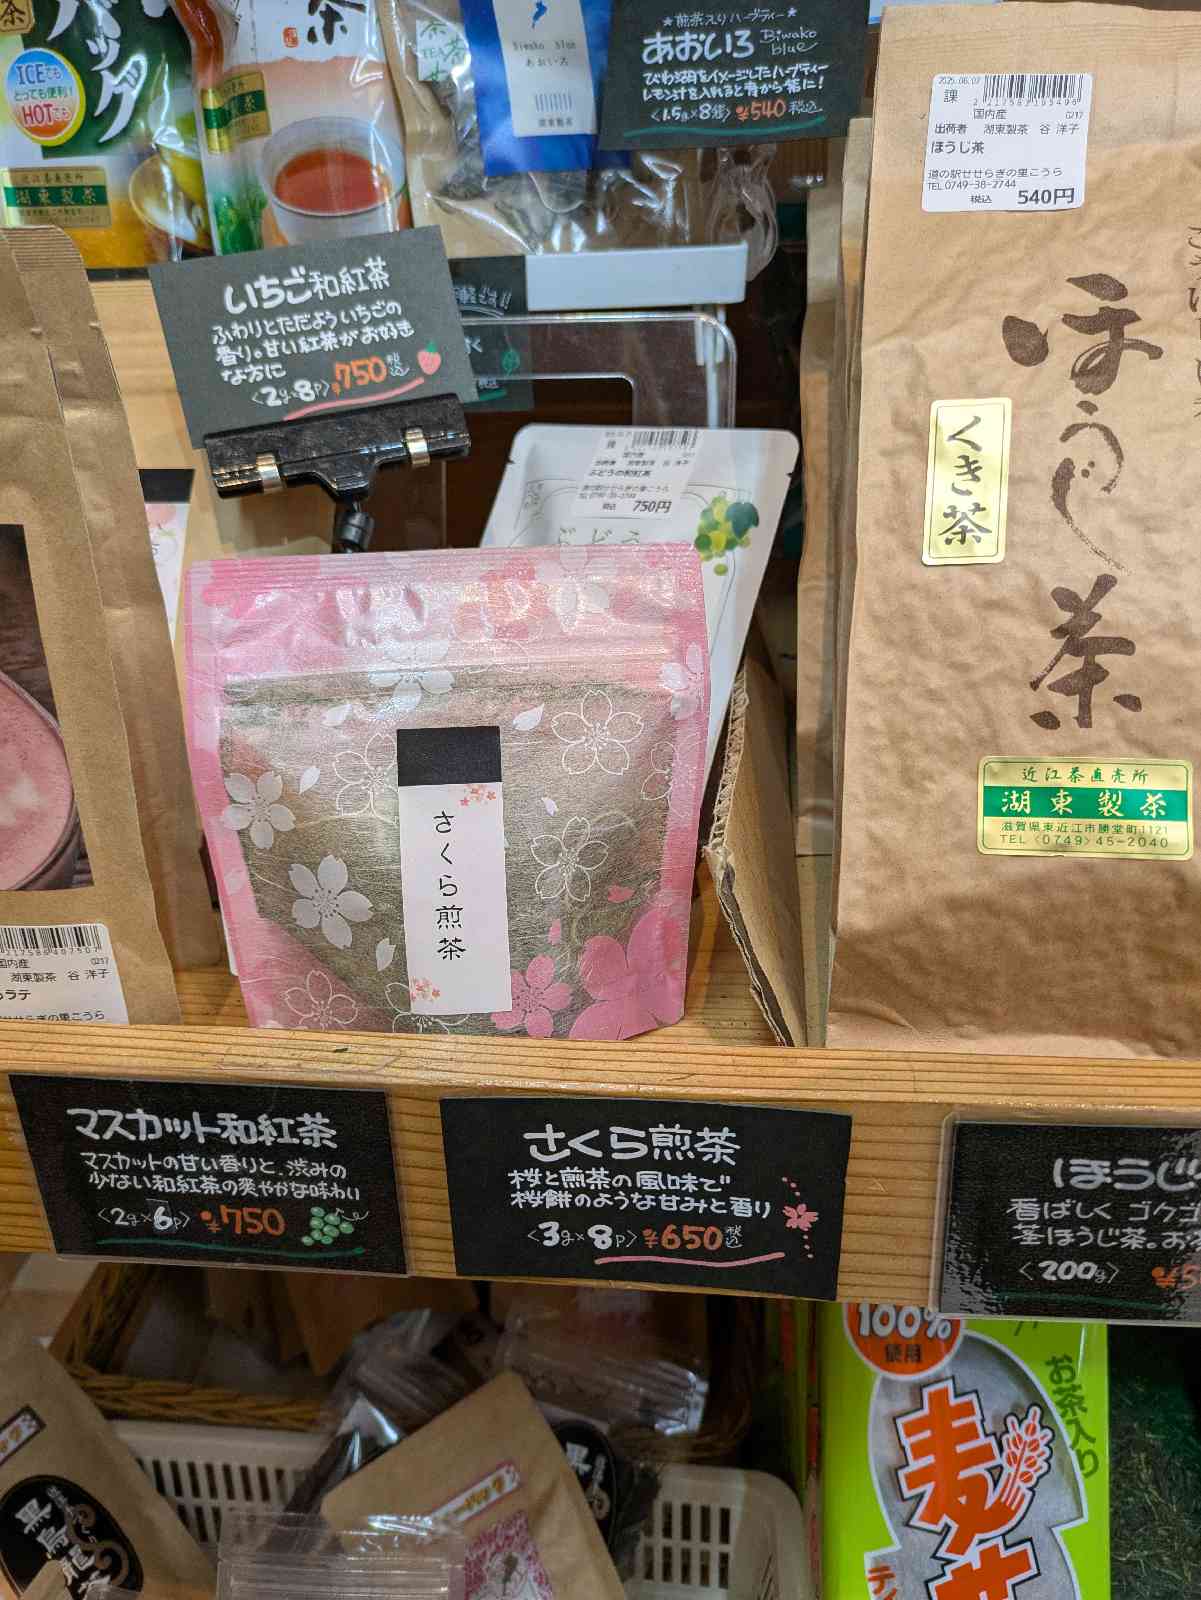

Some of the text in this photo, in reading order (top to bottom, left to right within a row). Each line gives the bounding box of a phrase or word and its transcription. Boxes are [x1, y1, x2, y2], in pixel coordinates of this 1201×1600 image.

[770, 42, 818, 56] blue
[973, 109, 1007, 120] 国内産
[934, 123, 968, 135] 出荷者
[983, 124, 1029, 135] 湖東製茶
[1039, 124, 1051, 135] 谷
[931, 140, 985, 154] ほうじ茶
[1017, 187, 1075, 205] 540円
[223, 256, 391, 314] いちご和紅茶
[220, 363, 287, 386] な方に
[938, 415, 992, 547] くき茶
[633, 500, 673, 513] 750円
[1001, 272, 1164, 730] ほうじ茶
[1022, 766, 1149, 783] 近江茶直売所
[1001, 789, 1169, 818] 湖東製茶
[433, 810, 467, 961] さくら煎茶
[66, 1108, 338, 1149] マスカット和紅茶
[523, 1123, 742, 1167] さくら煎茶
[508, 1166, 731, 1193] 桜と煎茶の風味で
[857, 1302, 952, 1340] 100%
[1045, 1354, 1099, 1478] お茶入り
